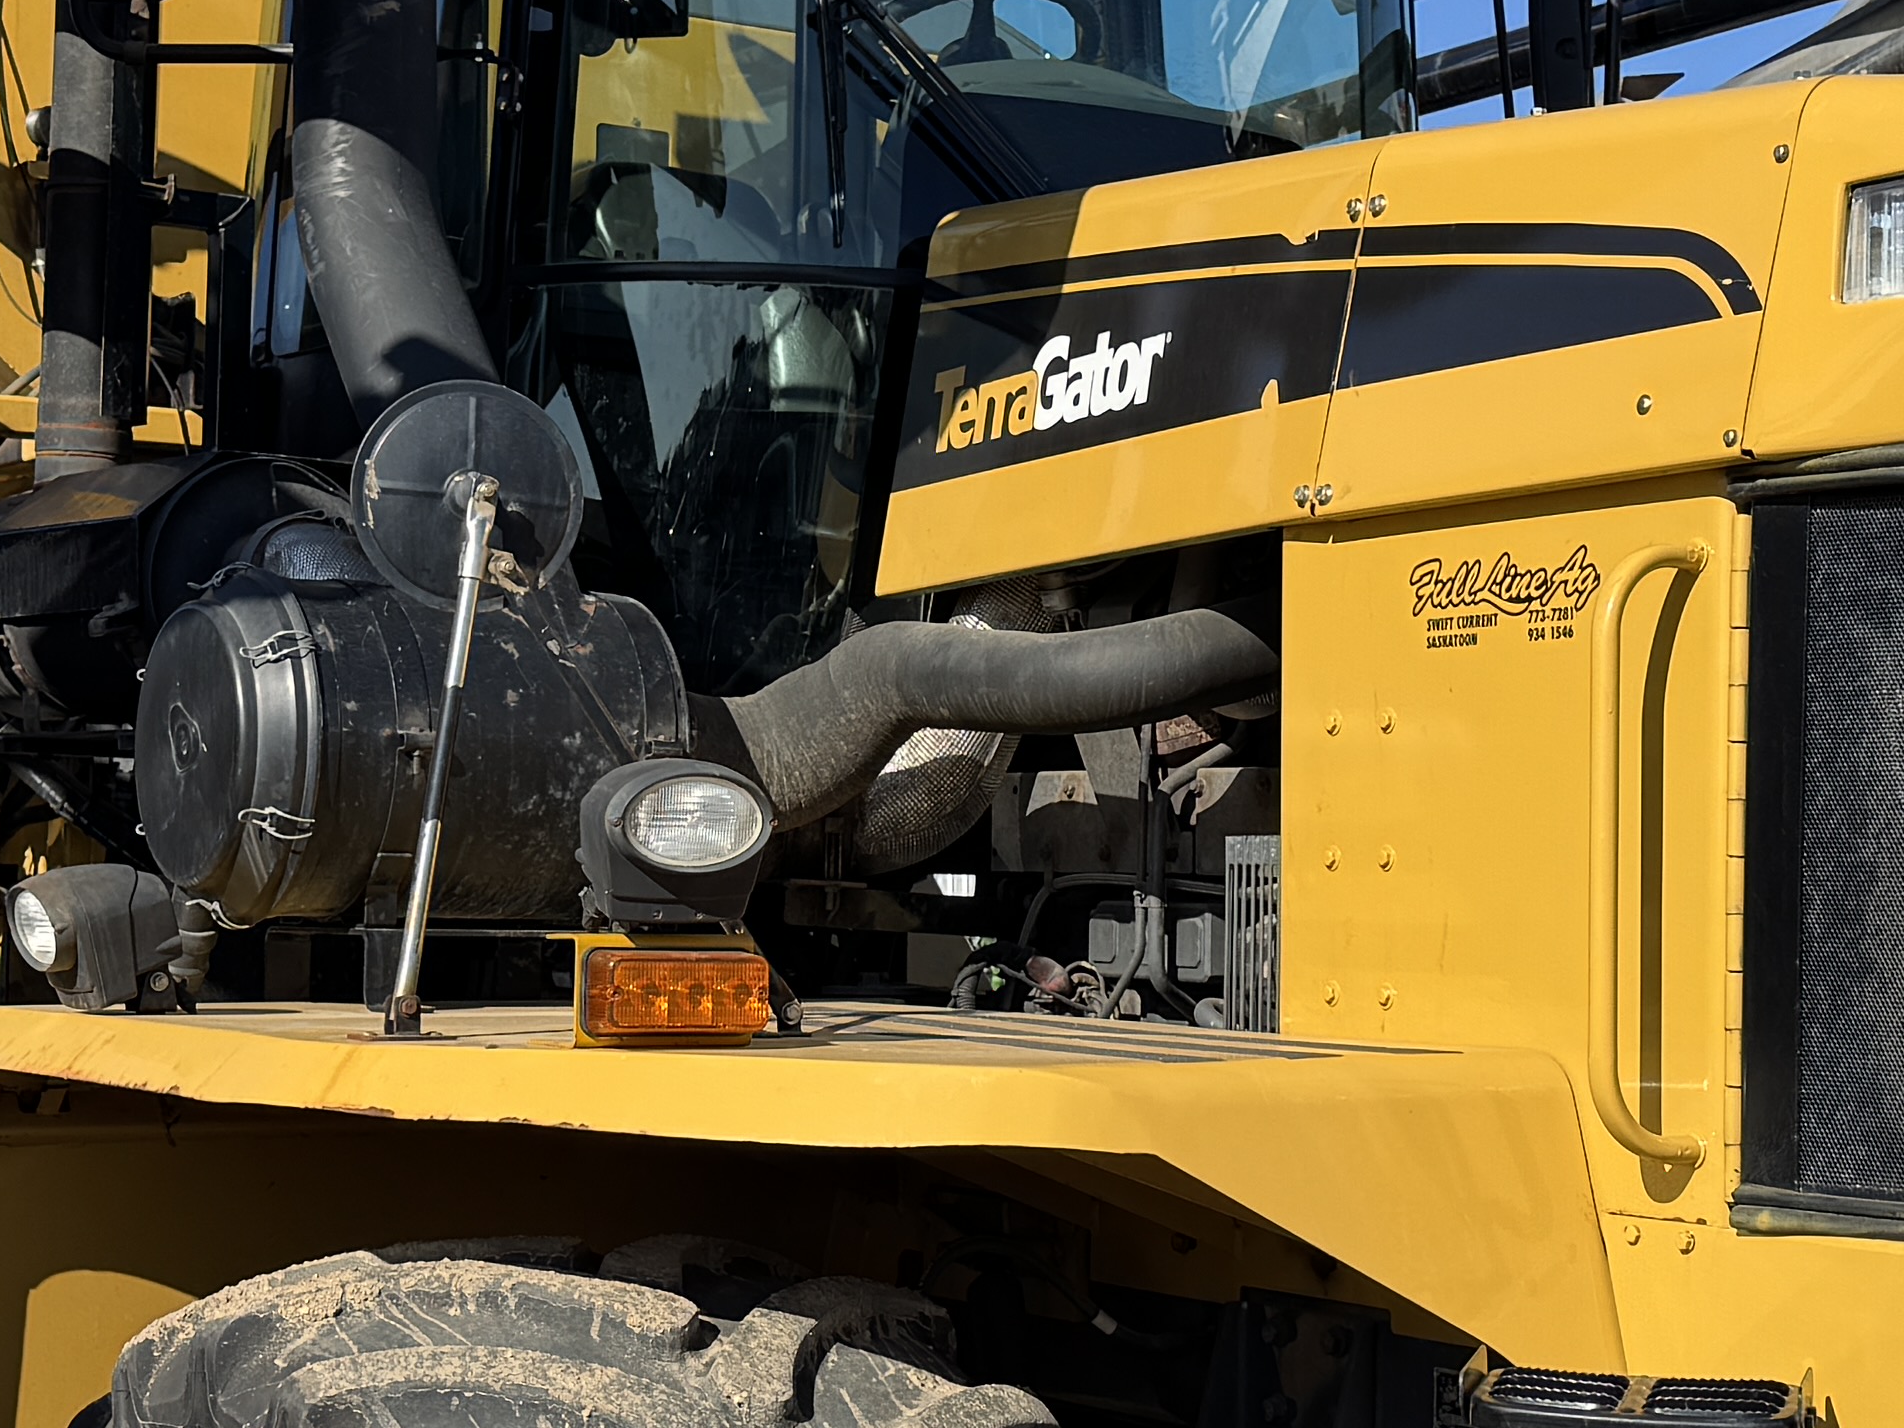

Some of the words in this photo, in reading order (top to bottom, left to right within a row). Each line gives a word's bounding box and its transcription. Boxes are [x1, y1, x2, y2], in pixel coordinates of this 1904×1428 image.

[933, 331, 1169, 454] TerraGator
[1409, 557, 1481, 617] Full
[1476, 552, 1548, 616] Line
[1541, 544, 1600, 612] Ag
[1426, 616, 1454, 632] SWIFT
[1457, 613, 1498, 629] CURRENT
[1527, 606, 1574, 624] 773-7281
[1426, 632, 1478, 649] SASKATOON
[1527, 626, 1545, 642] 934
[1551, 624, 1574, 640] 1546
